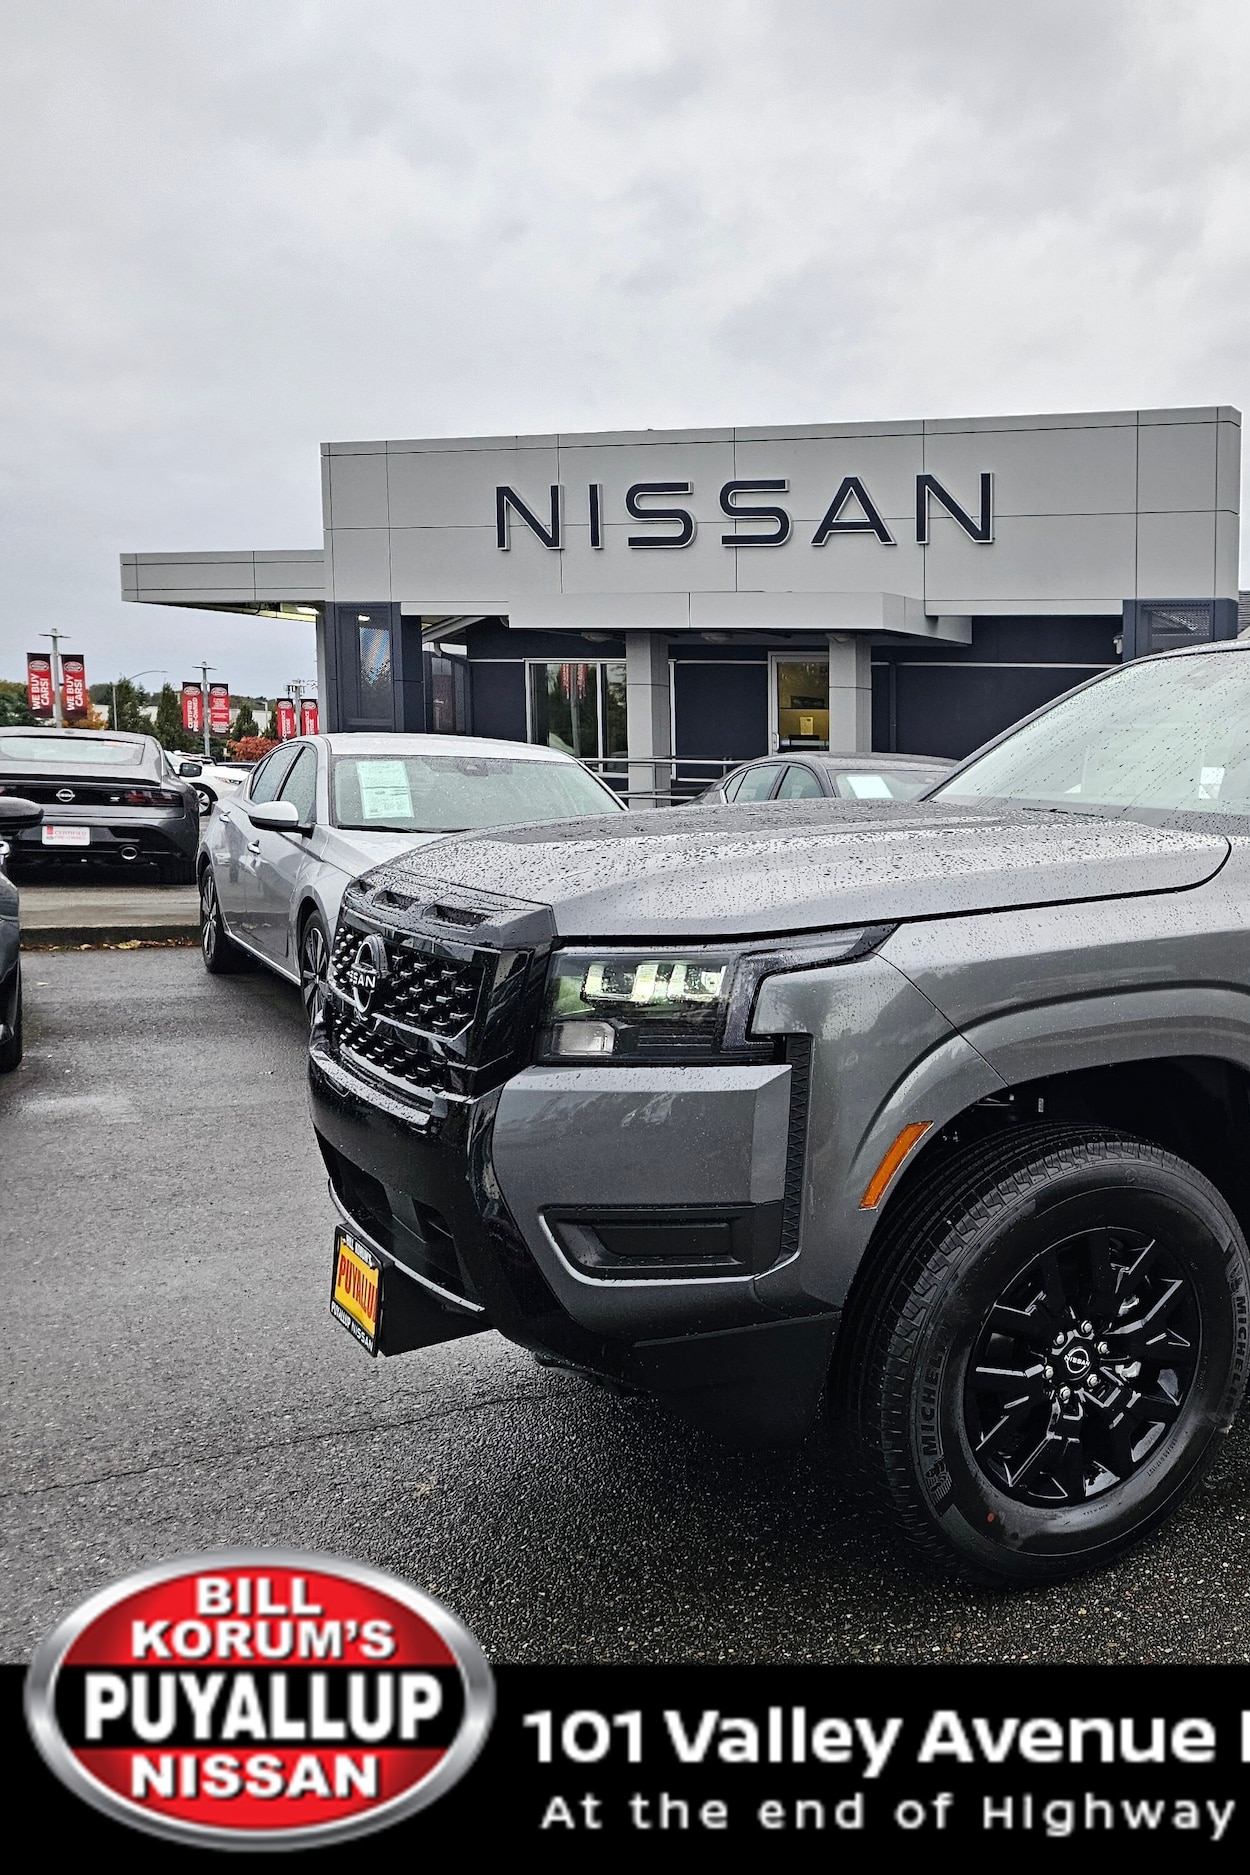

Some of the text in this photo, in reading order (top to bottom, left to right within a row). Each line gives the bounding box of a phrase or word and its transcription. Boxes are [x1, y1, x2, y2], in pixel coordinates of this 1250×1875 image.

[495, 472, 995, 551] NISSAN
[30, 673, 40, 694] BUY
[40, 678, 50, 706] CARS!
[65, 674, 74, 694] BUY
[74, 679, 84, 707] CARS!
[31, 693, 41, 710] WE
[66, 694, 75, 710] WE
[351, 1322, 374, 1351] NISSAN
[1064, 1355, 1090, 1367] NISSAN
